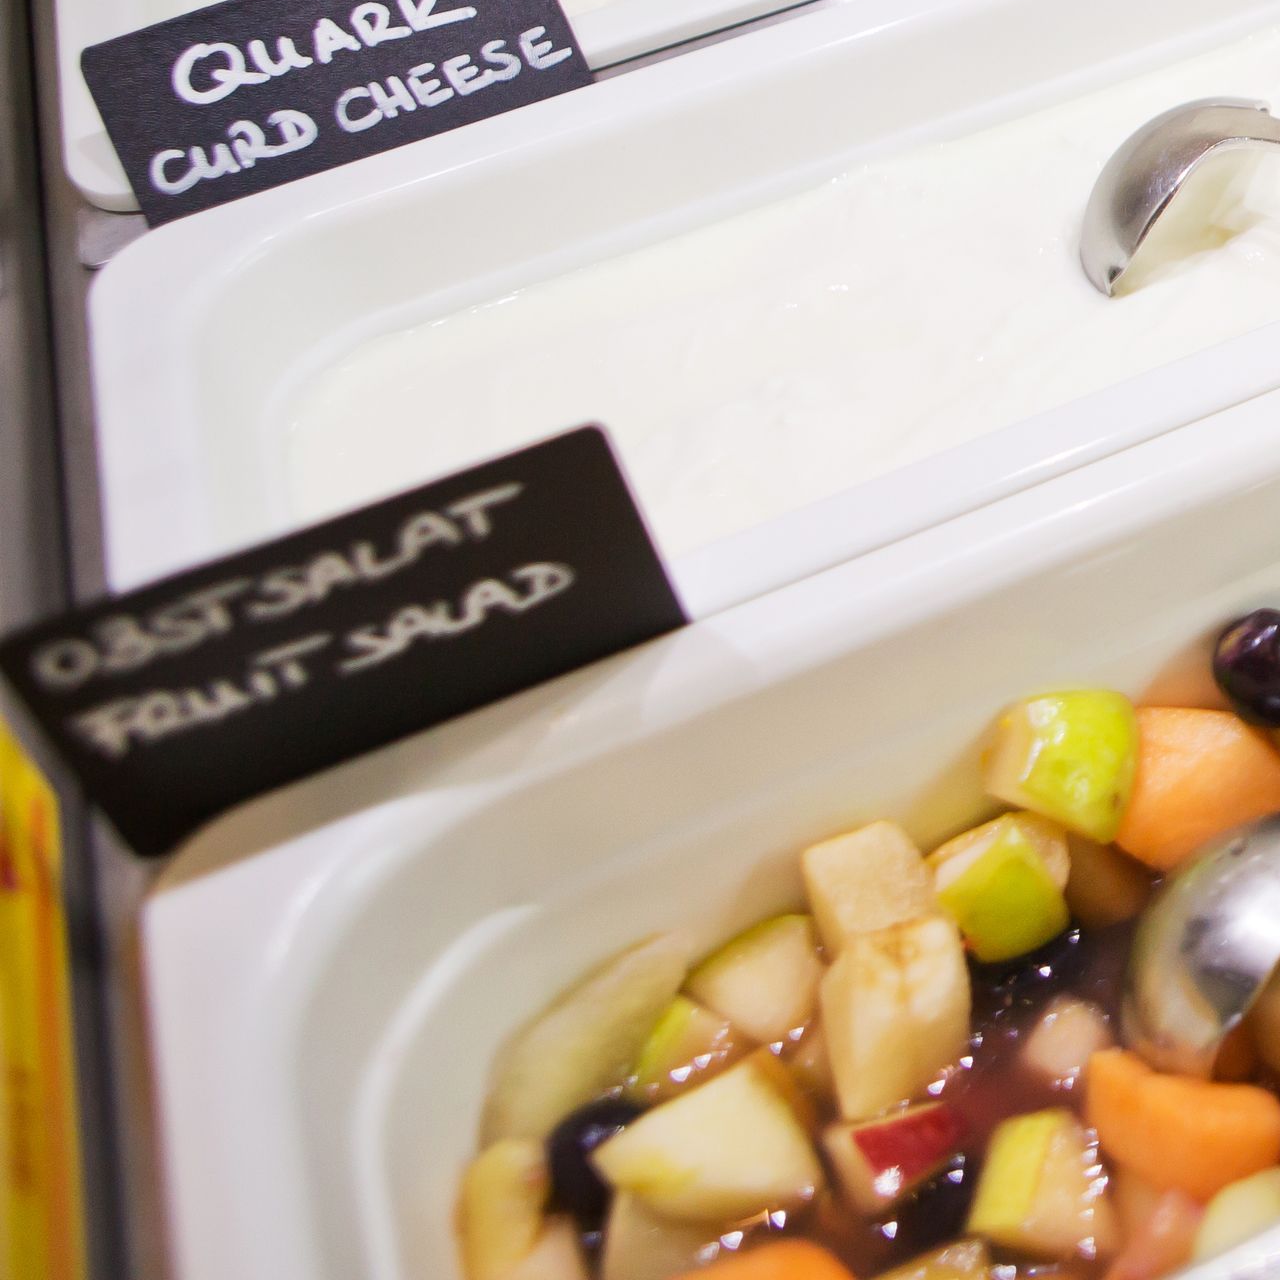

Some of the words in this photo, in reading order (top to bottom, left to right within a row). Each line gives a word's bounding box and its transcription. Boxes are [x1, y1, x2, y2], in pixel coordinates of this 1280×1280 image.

[148, 110, 319, 195] CURD
[334, 24, 574, 134] CHEESE
[72, 633, 333, 757] FRUIT
[339, 561, 576, 678] SALAD
